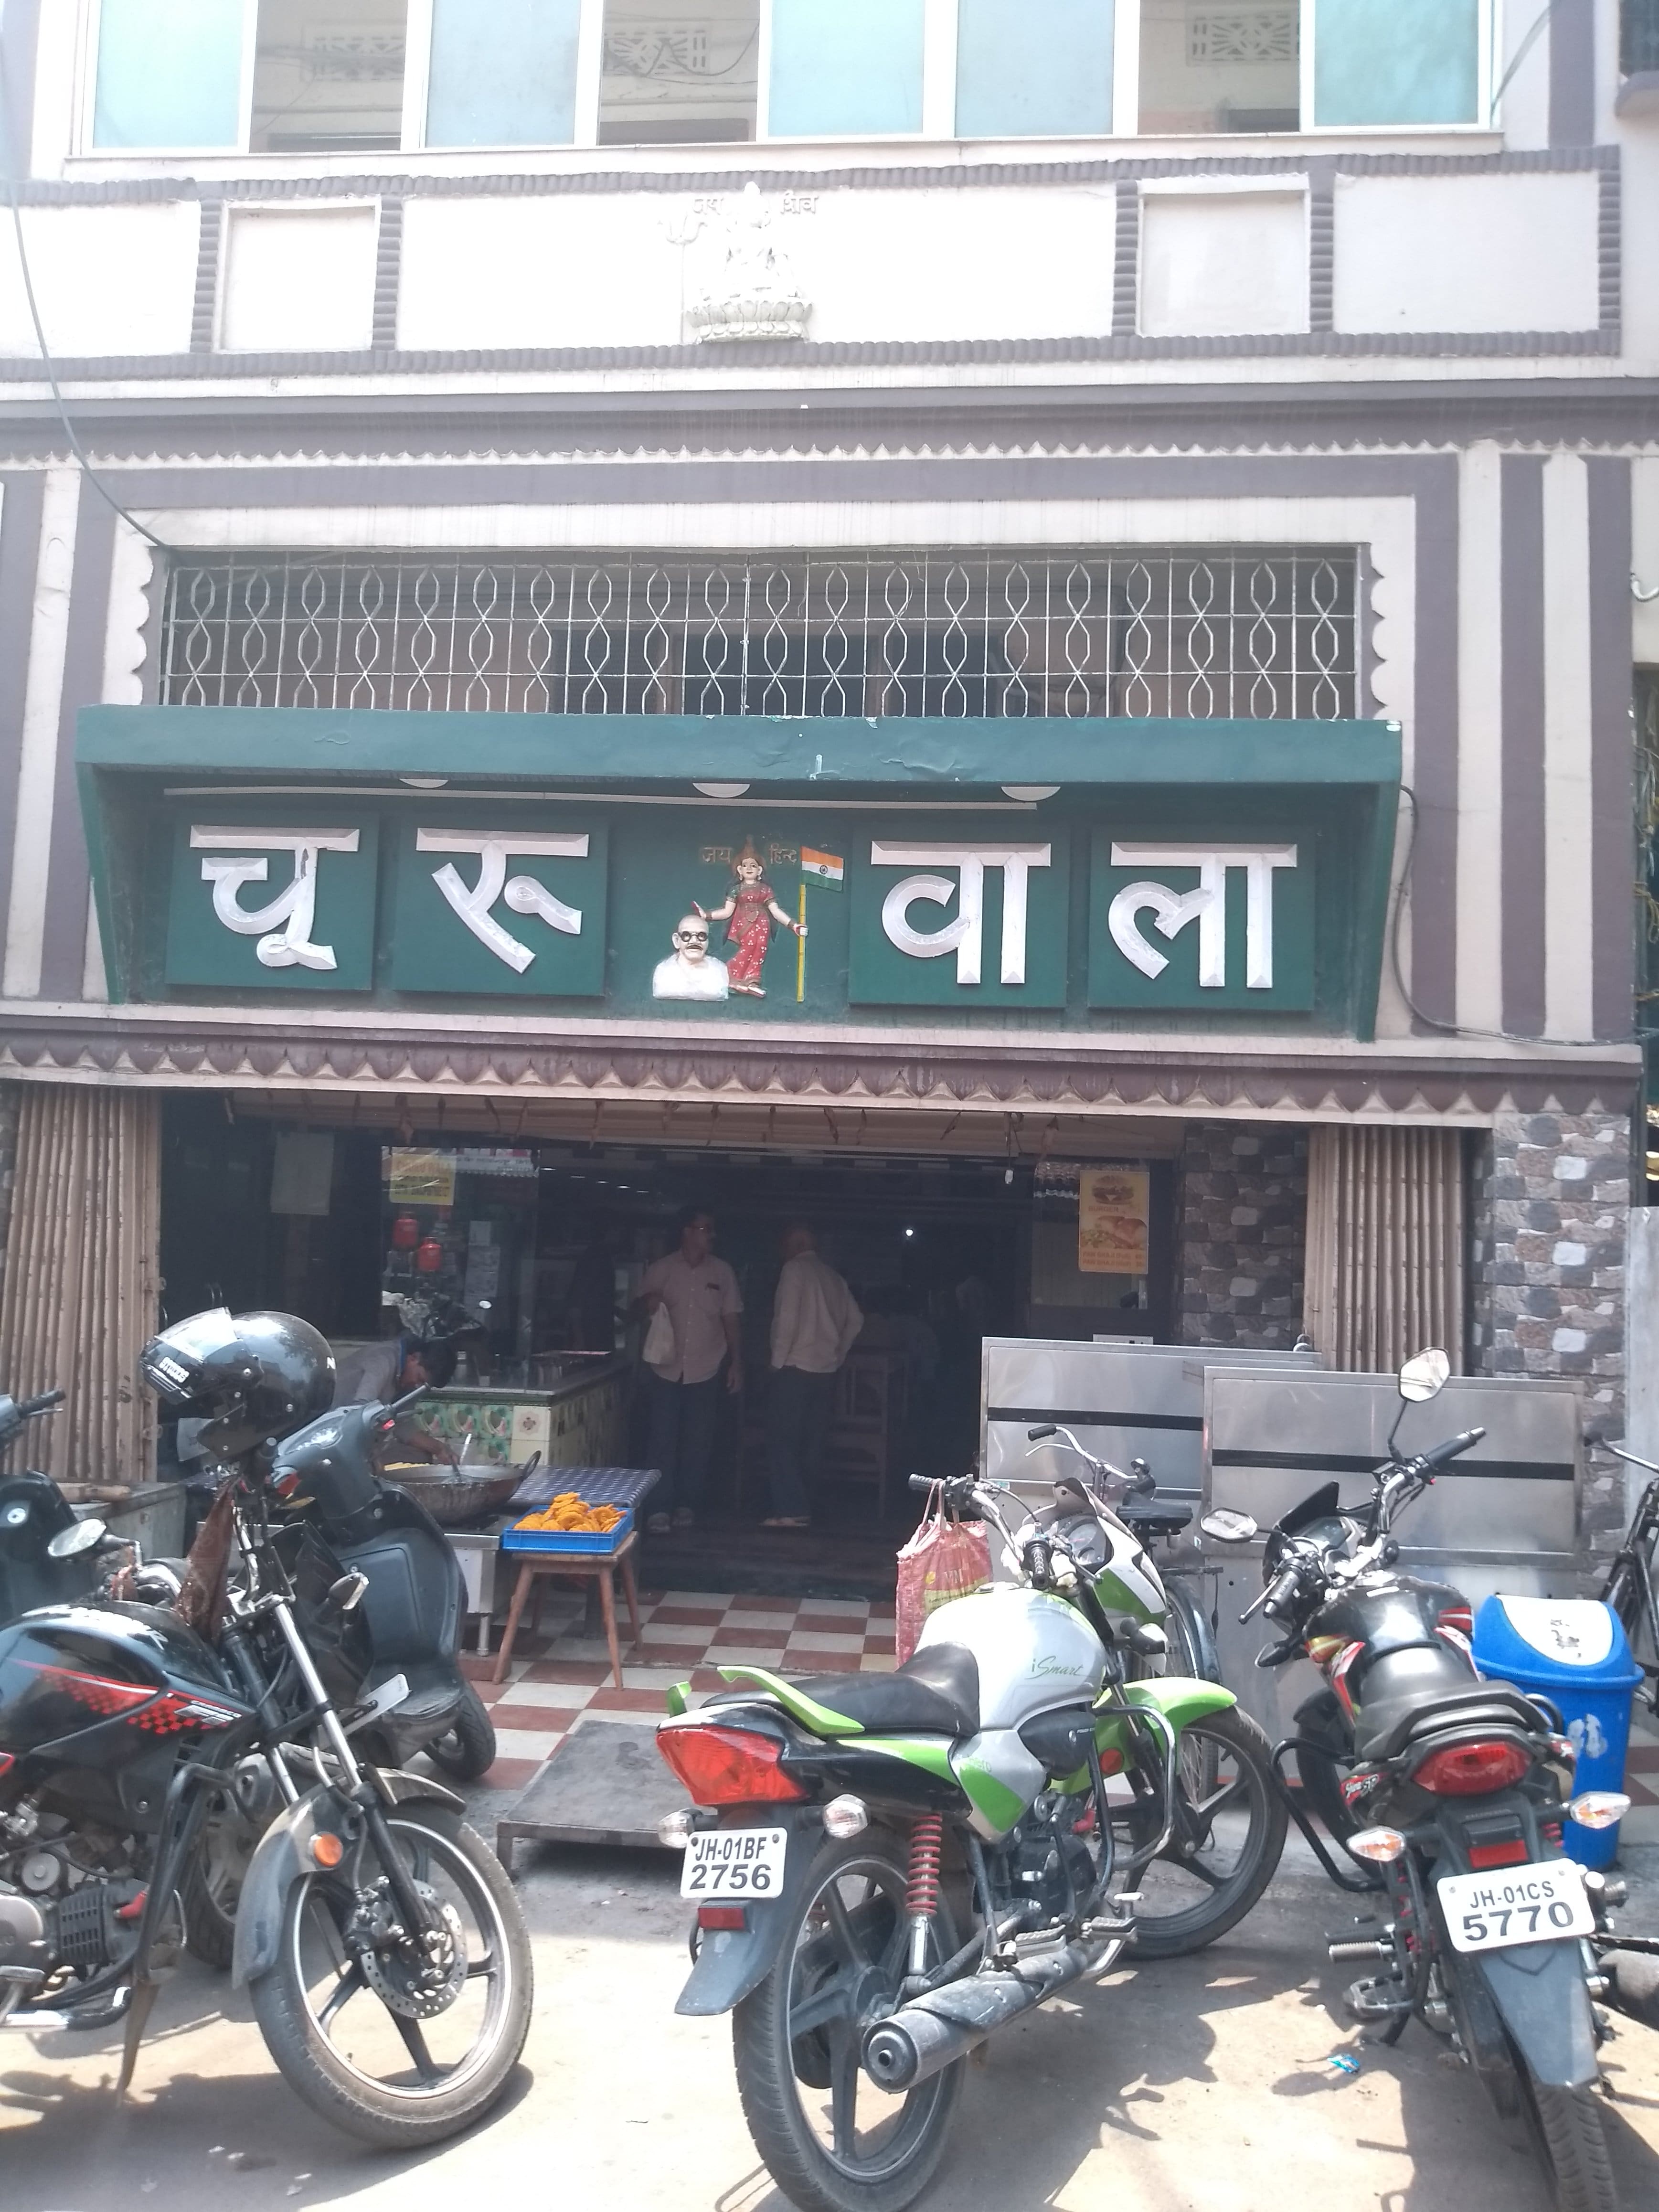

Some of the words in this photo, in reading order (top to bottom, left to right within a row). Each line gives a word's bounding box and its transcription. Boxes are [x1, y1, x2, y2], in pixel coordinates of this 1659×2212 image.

[702, 846, 734, 864] जय
[768, 842, 798, 865] हिन्द
[190, 825, 589, 974] चूरू
[871, 840, 1297, 989] वाला
[695, 1836, 767, 1861] JH-01BF
[689, 1863, 772, 1890] 2756
[1469, 1880, 1554, 1909] JH-01CS
[1462, 1901, 1574, 1942] 5770
